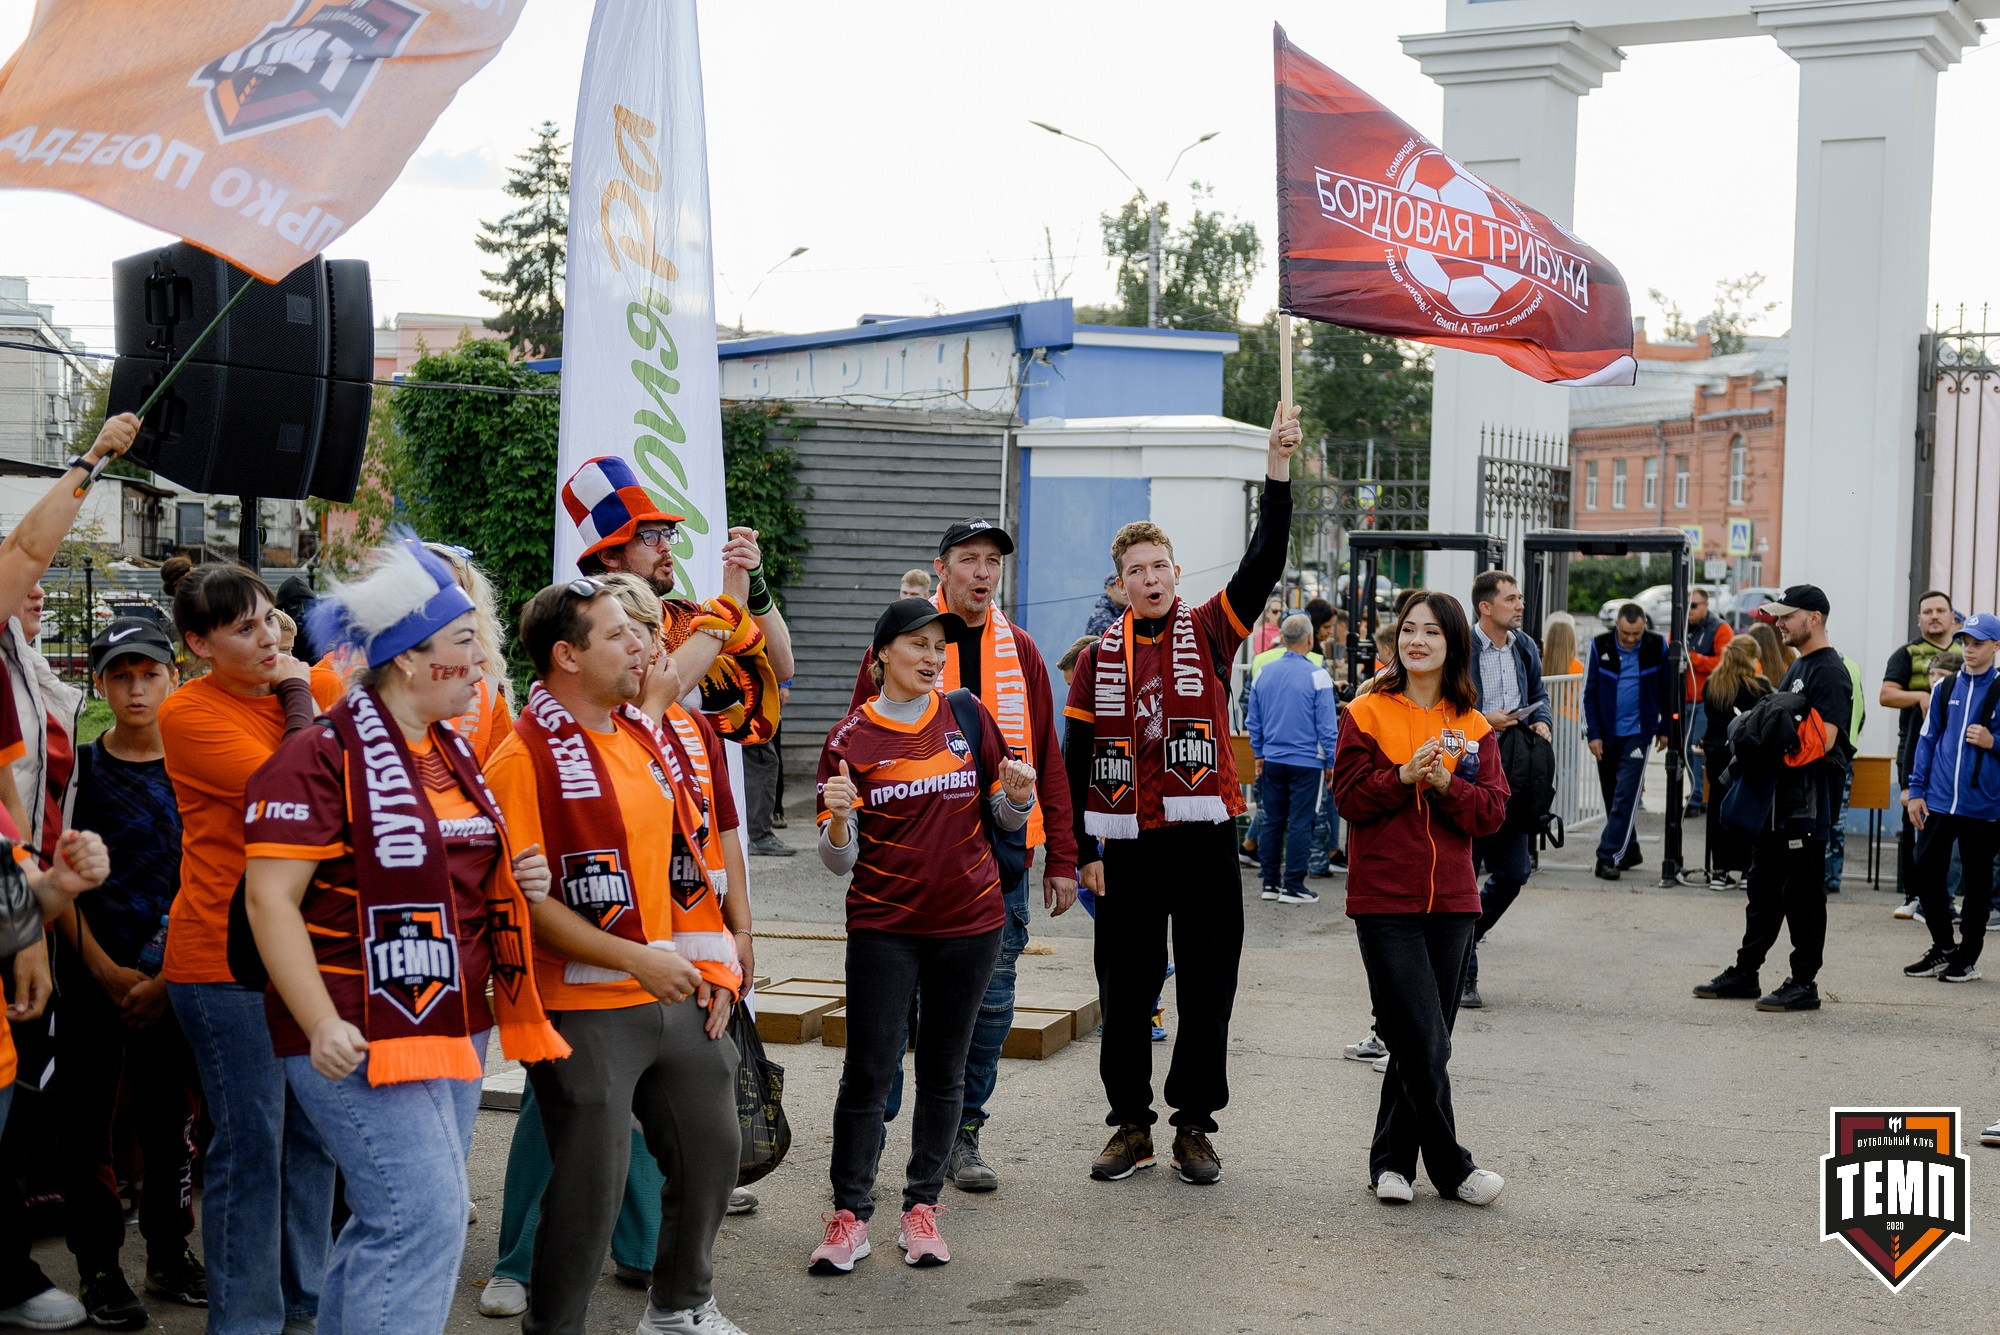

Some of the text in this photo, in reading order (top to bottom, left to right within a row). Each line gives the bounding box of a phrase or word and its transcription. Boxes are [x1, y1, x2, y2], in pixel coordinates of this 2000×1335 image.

[1384, 136, 1418, 181] Команда!
[1315, 171, 1590, 307] БОРДОВАЯ ТРИБУНА
[1383, 248, 1405, 283] Наша
[1401, 281, 1432, 313] жизнь!
[1432, 310, 1459, 332] Темп!
[1460, 322, 1470, 334] А
[1471, 322, 1500, 335] Темп
[1505, 289, 1545, 327] чемпион!
[1095, 661, 1126, 717] ТЕМП
[547, 733, 602, 800] ТЕМП
[1094, 757, 1131, 783] ТЕМП
[1168, 738, 1213, 766] ТЕМП
[869, 770, 977, 808] ПРОДИНВЕСТ
[264, 802, 311, 821] ПСБ
[567, 875, 626, 906] ТЕМП
[373, 939, 451, 982] ТЕМП
